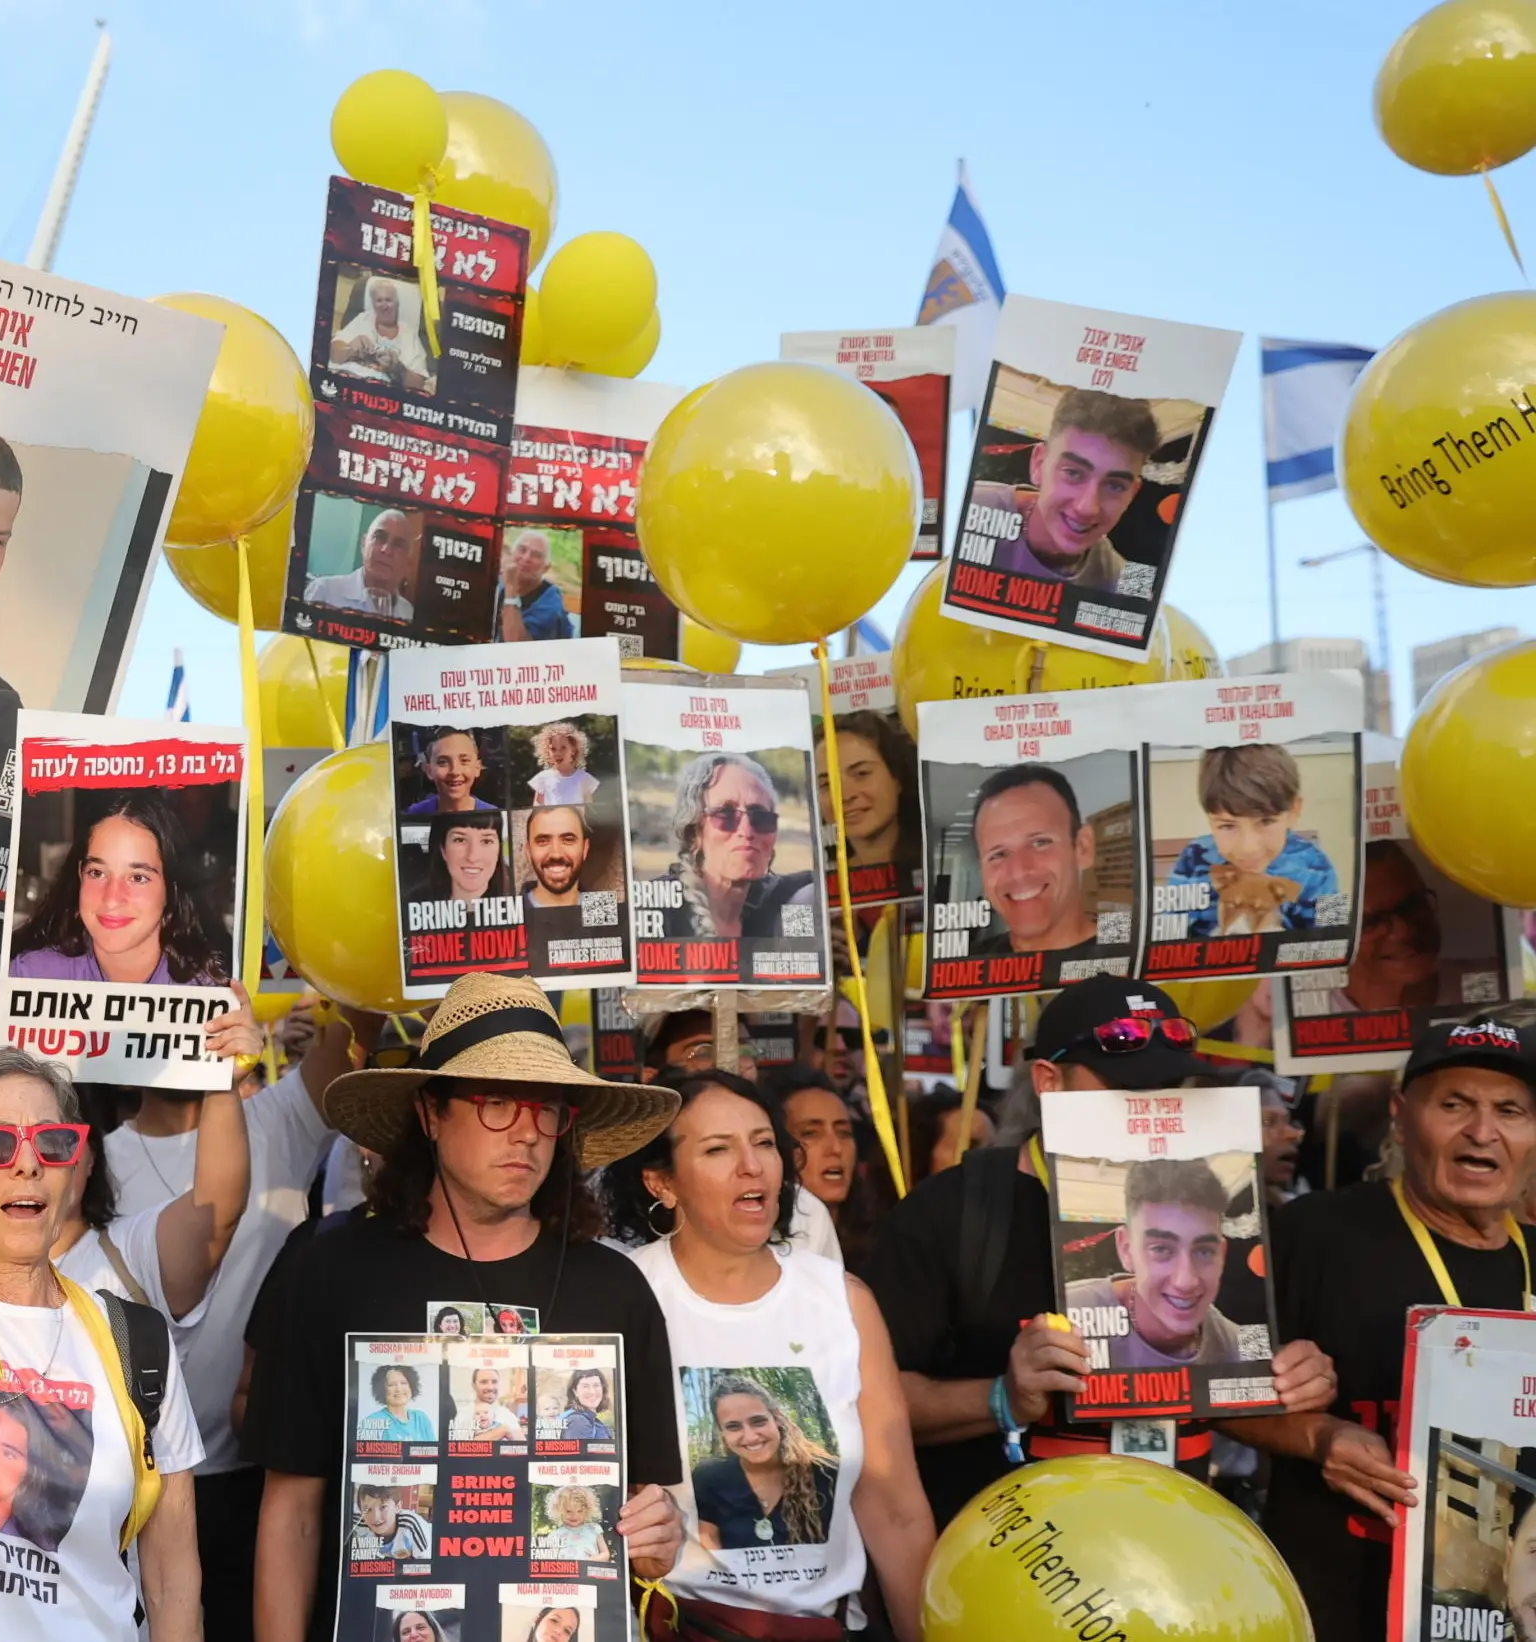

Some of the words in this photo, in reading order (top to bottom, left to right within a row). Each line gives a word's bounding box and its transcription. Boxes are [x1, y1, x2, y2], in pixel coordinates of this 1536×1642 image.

[452, 249, 497, 282] לא
[22, 285, 84, 318] לחזור
[90, 305, 139, 335] חייב
[348, 422, 433, 457] ממשפחת
[433, 443, 470, 465] רבע
[337, 449, 426, 495] איתנו
[590, 448, 633, 471] רבע
[1380, 463, 1452, 510] Bring
[1431, 416, 1521, 475] Them
[431, 472, 477, 506] לא
[963, 503, 1023, 541] BRING
[432, 535, 484, 563] חטוף
[957, 532, 997, 566] HIM
[951, 564, 1004, 601] HOME
[1006, 576, 1064, 613] NOW!
[403, 693, 441, 713] YAHEL,
[443, 691, 476, 711] NEVE,
[478, 690, 499, 707] TAL
[501, 688, 524, 706] AND
[526, 687, 545, 704] ADI
[548, 684, 598, 704] SHOHAM
[679, 713, 711, 729] GOREN
[713, 715, 742, 730] MAYA
[983, 722, 1012, 742] OHAD
[1013, 719, 1073, 740] YAHALOMI
[30, 753, 78, 779] לעזה
[83, 755, 145, 778] נחטפה
[180, 754, 206, 774] בת
[210, 751, 236, 774] גלי
[1153, 882, 1212, 914] BRING
[408, 899, 468, 932] BRING
[471, 896, 525, 928] THEM
[933, 899, 992, 931] BRING
[1150, 911, 1190, 942] HIM
[410, 930, 466, 965] HOME
[469, 925, 529, 961] NOW!
[548, 947, 589, 965] FAMILIES
[589, 946, 623, 964] FORUM
[685, 939, 740, 971] NOW!
[932, 929, 970, 959] HIM
[1148, 941, 1204, 970] HOME
[1205, 935, 1262, 967] NOW!
[931, 958, 984, 989] HOME
[987, 952, 1044, 985] NOW!
[8, 989, 94, 1020] אותם
[103, 994, 230, 1025] מחזירים
[1295, 1017, 1347, 1044] HOME
[1352, 1010, 1411, 1042] NOW!
[1133, 1367, 1192, 1402] NOW!
[451, 1475, 516, 1490] BRING
[452, 1492, 513, 1506] THEM
[448, 1509, 513, 1524] HOME
[439, 1536, 525, 1557] NOW!
[980, 1483, 1033, 1548] Bring
[1011, 1520, 1082, 1605] Them
[1430, 1605, 1506, 1642] BRING
